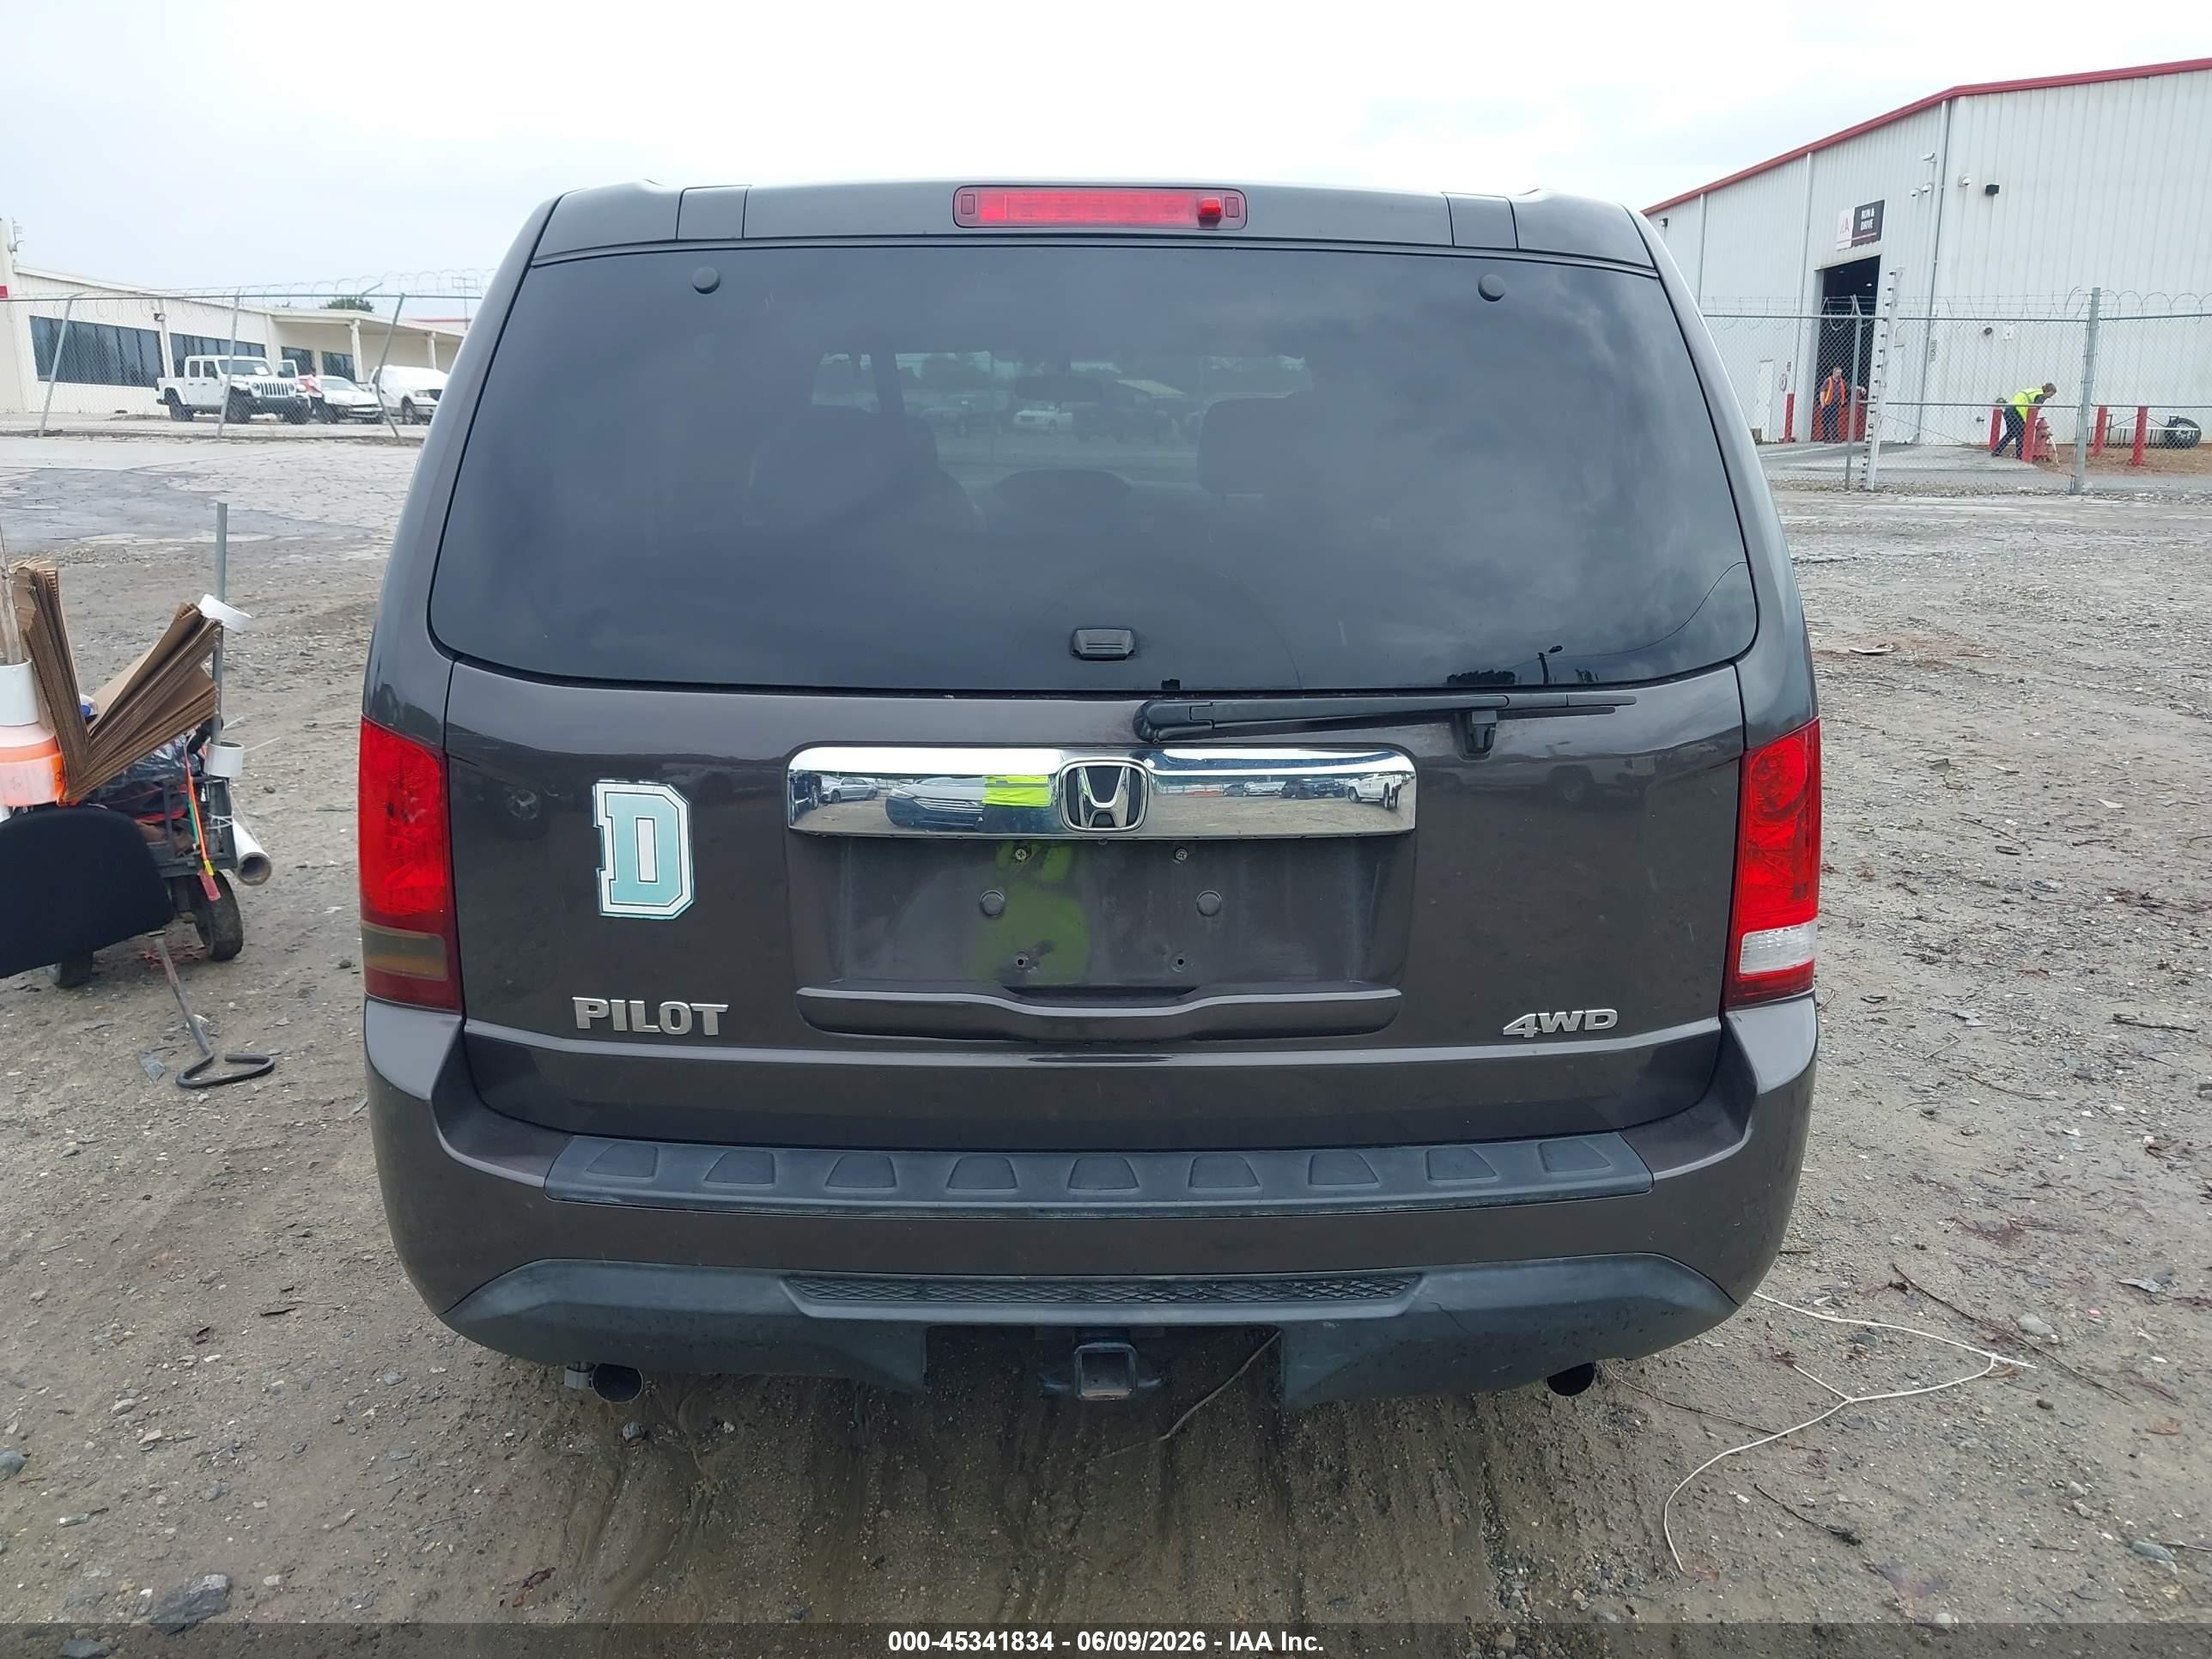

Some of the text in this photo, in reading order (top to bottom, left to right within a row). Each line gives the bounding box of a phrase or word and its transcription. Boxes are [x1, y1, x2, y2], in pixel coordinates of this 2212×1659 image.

[1860, 218, 1874, 231] DRIVE
[1861, 209, 1871, 220] RUN
[592, 779, 695, 920] D
[571, 996, 729, 1036] PILOT
[1503, 1008, 1619, 1038] 4WD
